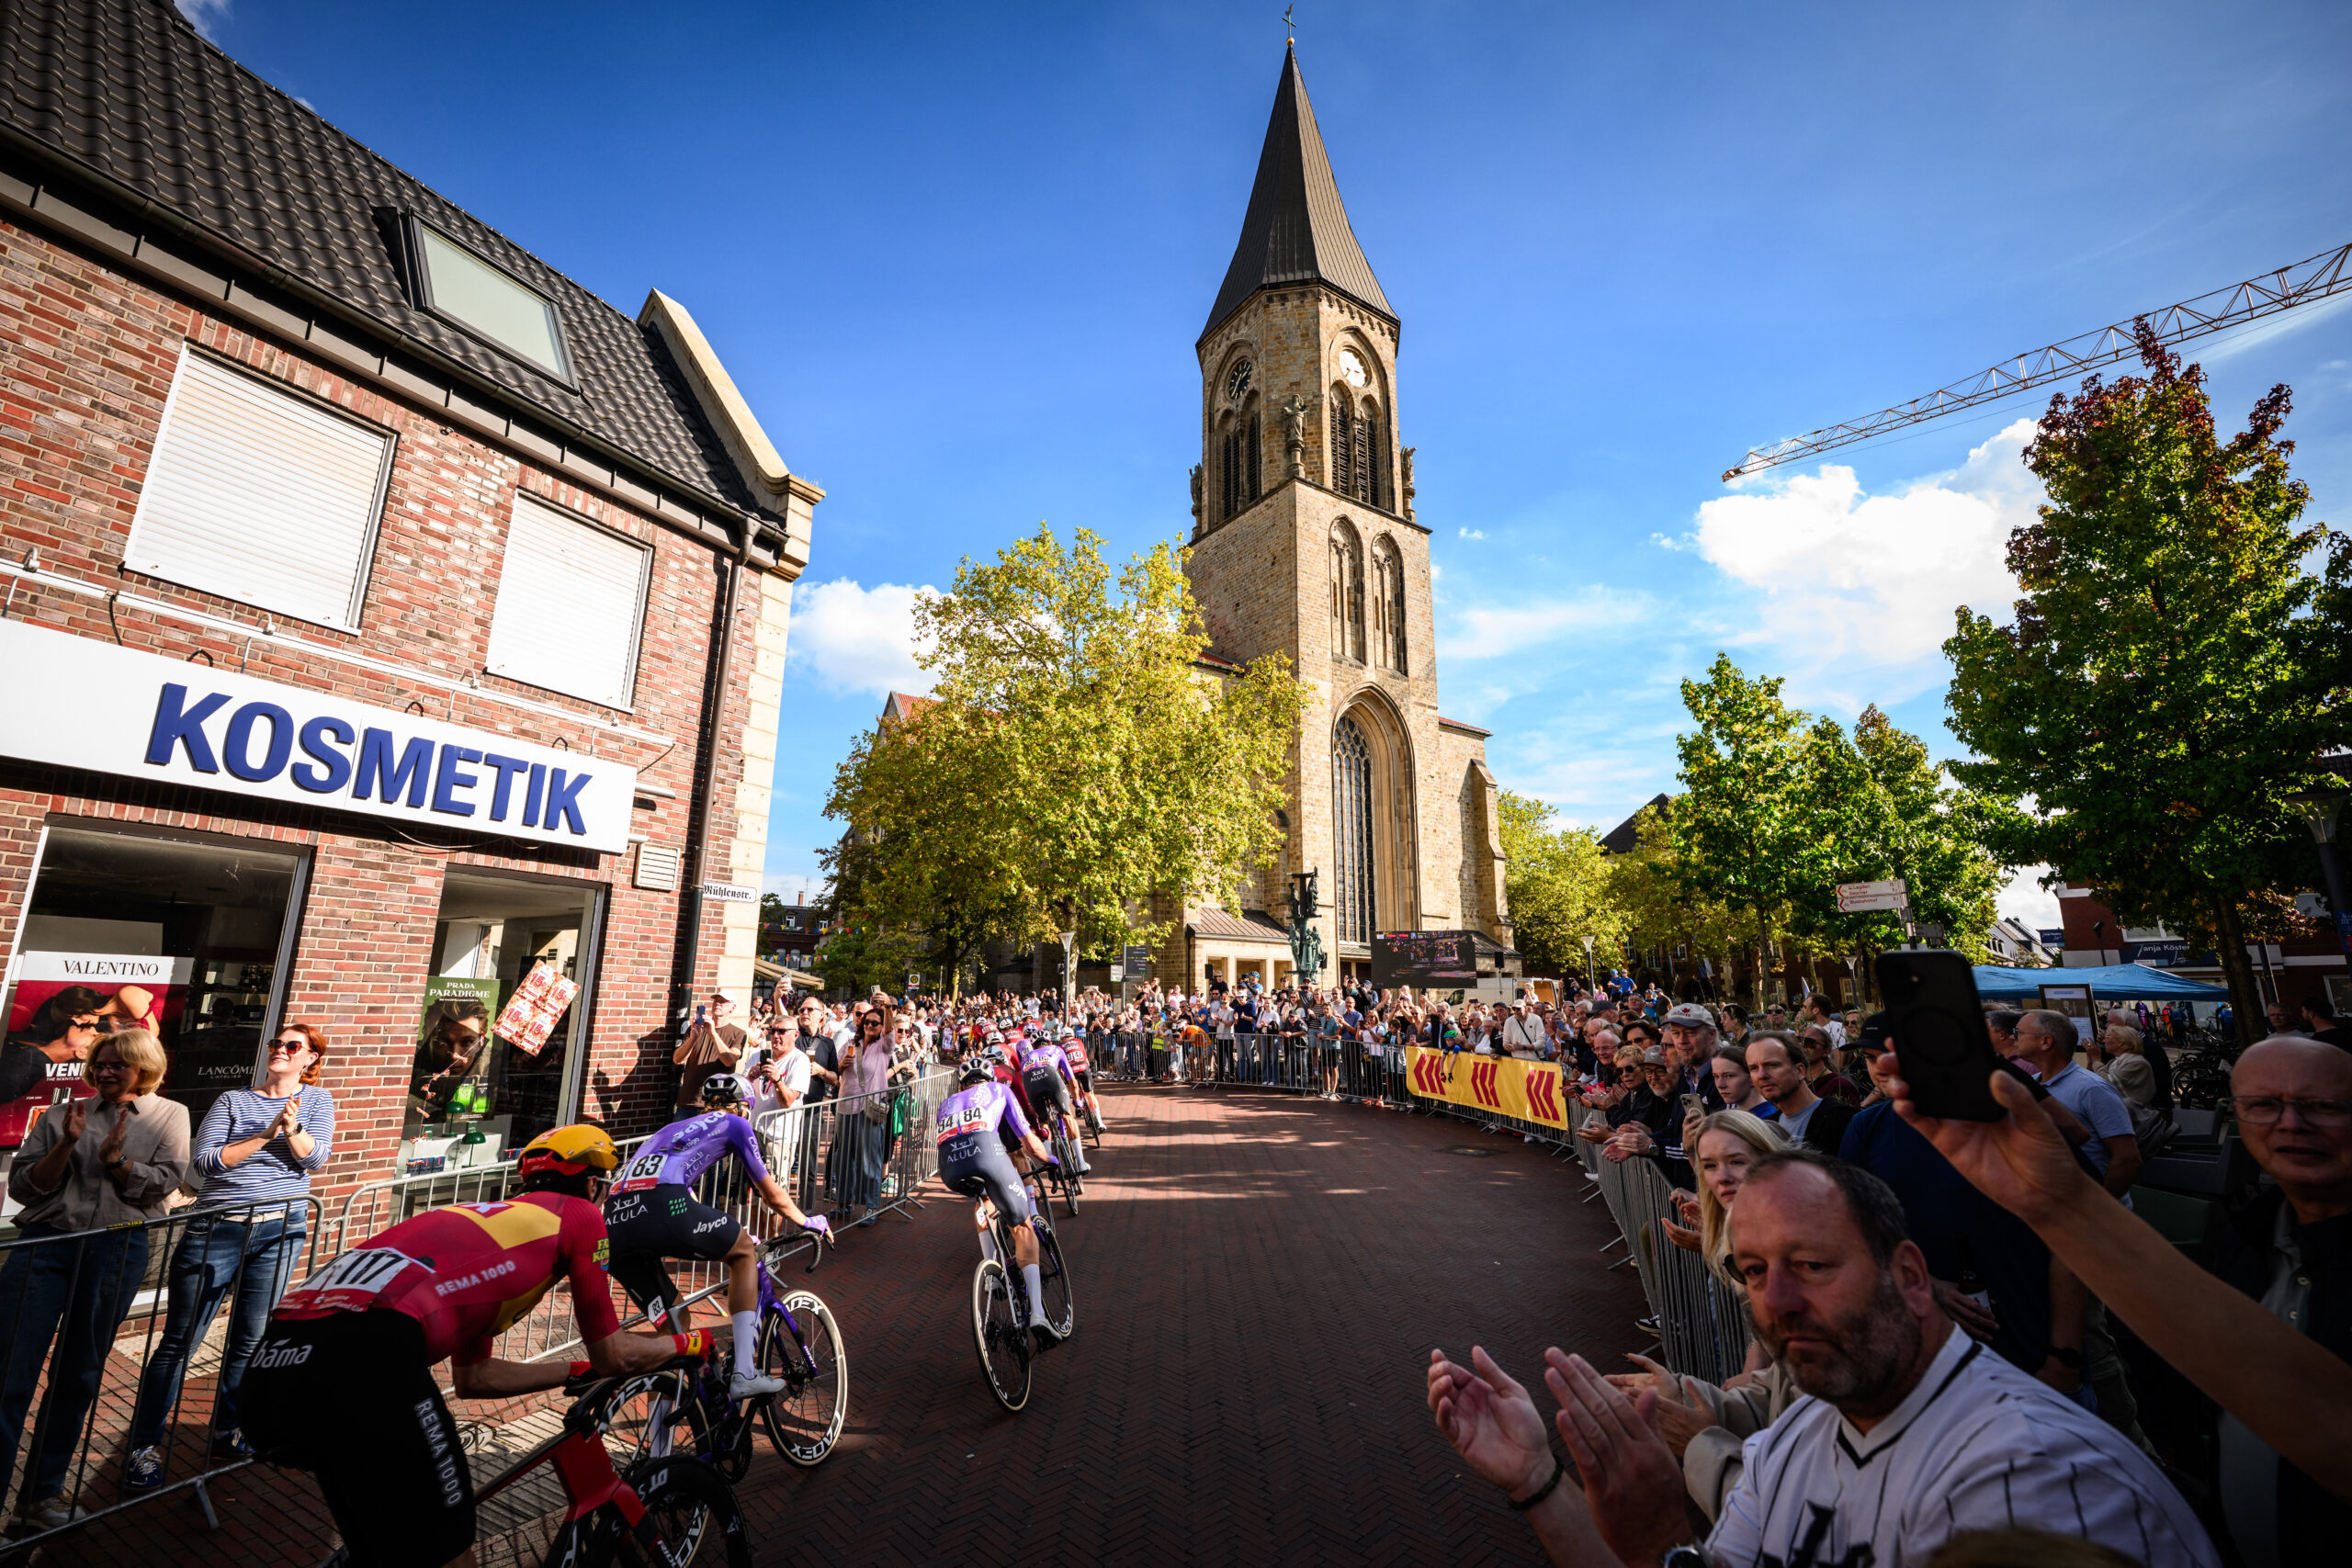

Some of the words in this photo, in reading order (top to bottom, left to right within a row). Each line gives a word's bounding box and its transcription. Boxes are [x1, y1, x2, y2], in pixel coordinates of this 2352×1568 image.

[144, 682, 594, 836] KOSMETIK
[702, 884, 752, 900] Mühlenstr.
[63, 960, 159, 976] VALENTINO
[429, 988, 491, 998] PARADIGME
[447, 981, 475, 989] PRADA
[963, 1107, 982, 1122] 84
[946, 1145, 981, 1164] ALULA
[632, 1155, 663, 1178] 83
[605, 1204, 648, 1226] ALULA
[693, 1215, 728, 1235] Jayco
[435, 1276, 481, 1296] REMA
[481, 1259, 516, 1281] 1000
[790, 1410, 842, 1460] CADEX
[414, 1398, 447, 1458] REMA
[436, 1454, 463, 1506] 1000
